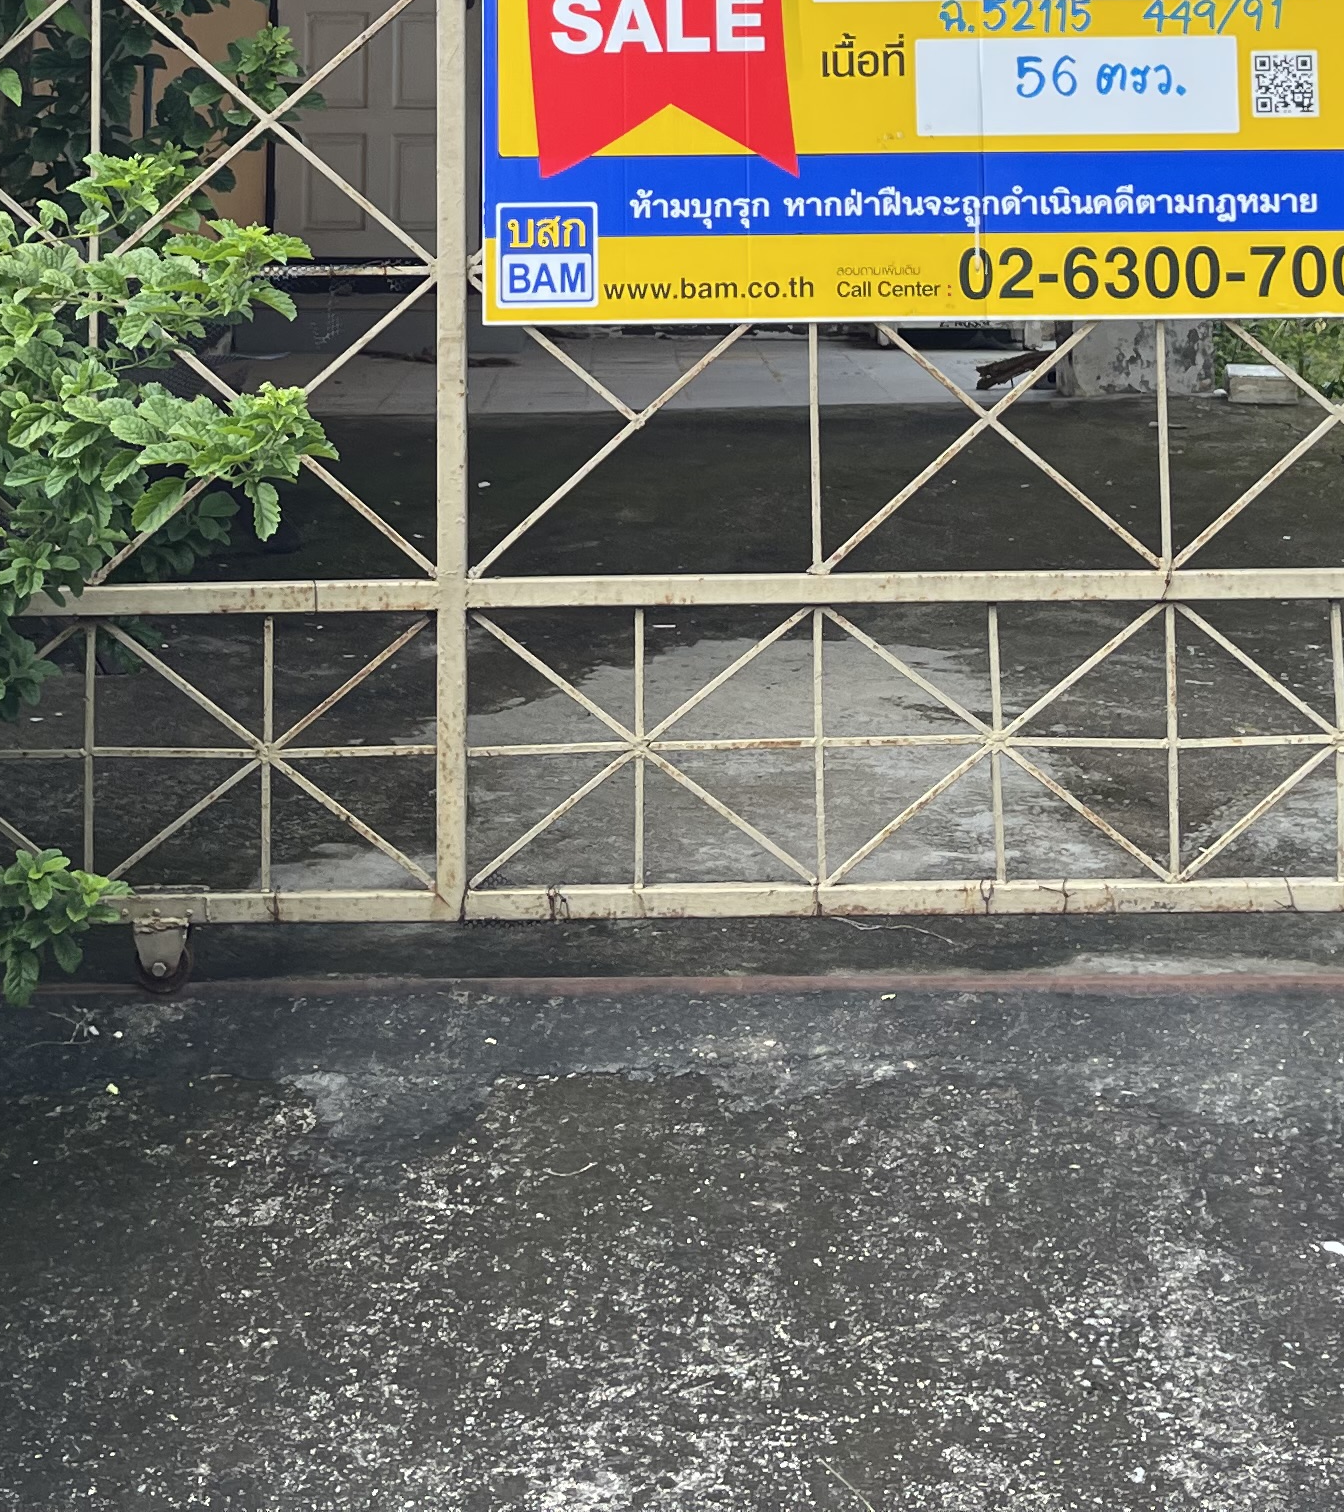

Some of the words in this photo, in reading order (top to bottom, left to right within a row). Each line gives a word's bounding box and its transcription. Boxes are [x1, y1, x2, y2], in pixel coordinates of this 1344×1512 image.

[822, 33, 906, 78] เนื้อที่
[1016, 54, 1078, 98] 56
[629, 188, 771, 230] ห้ามบุกรุก
[506, 215, 587, 249] บสก
[508, 262, 587, 295] BAM
[603, 275, 816, 301] www.bam.co.th
[836, 280, 873, 298] Call
[877, 280, 941, 298] Center
